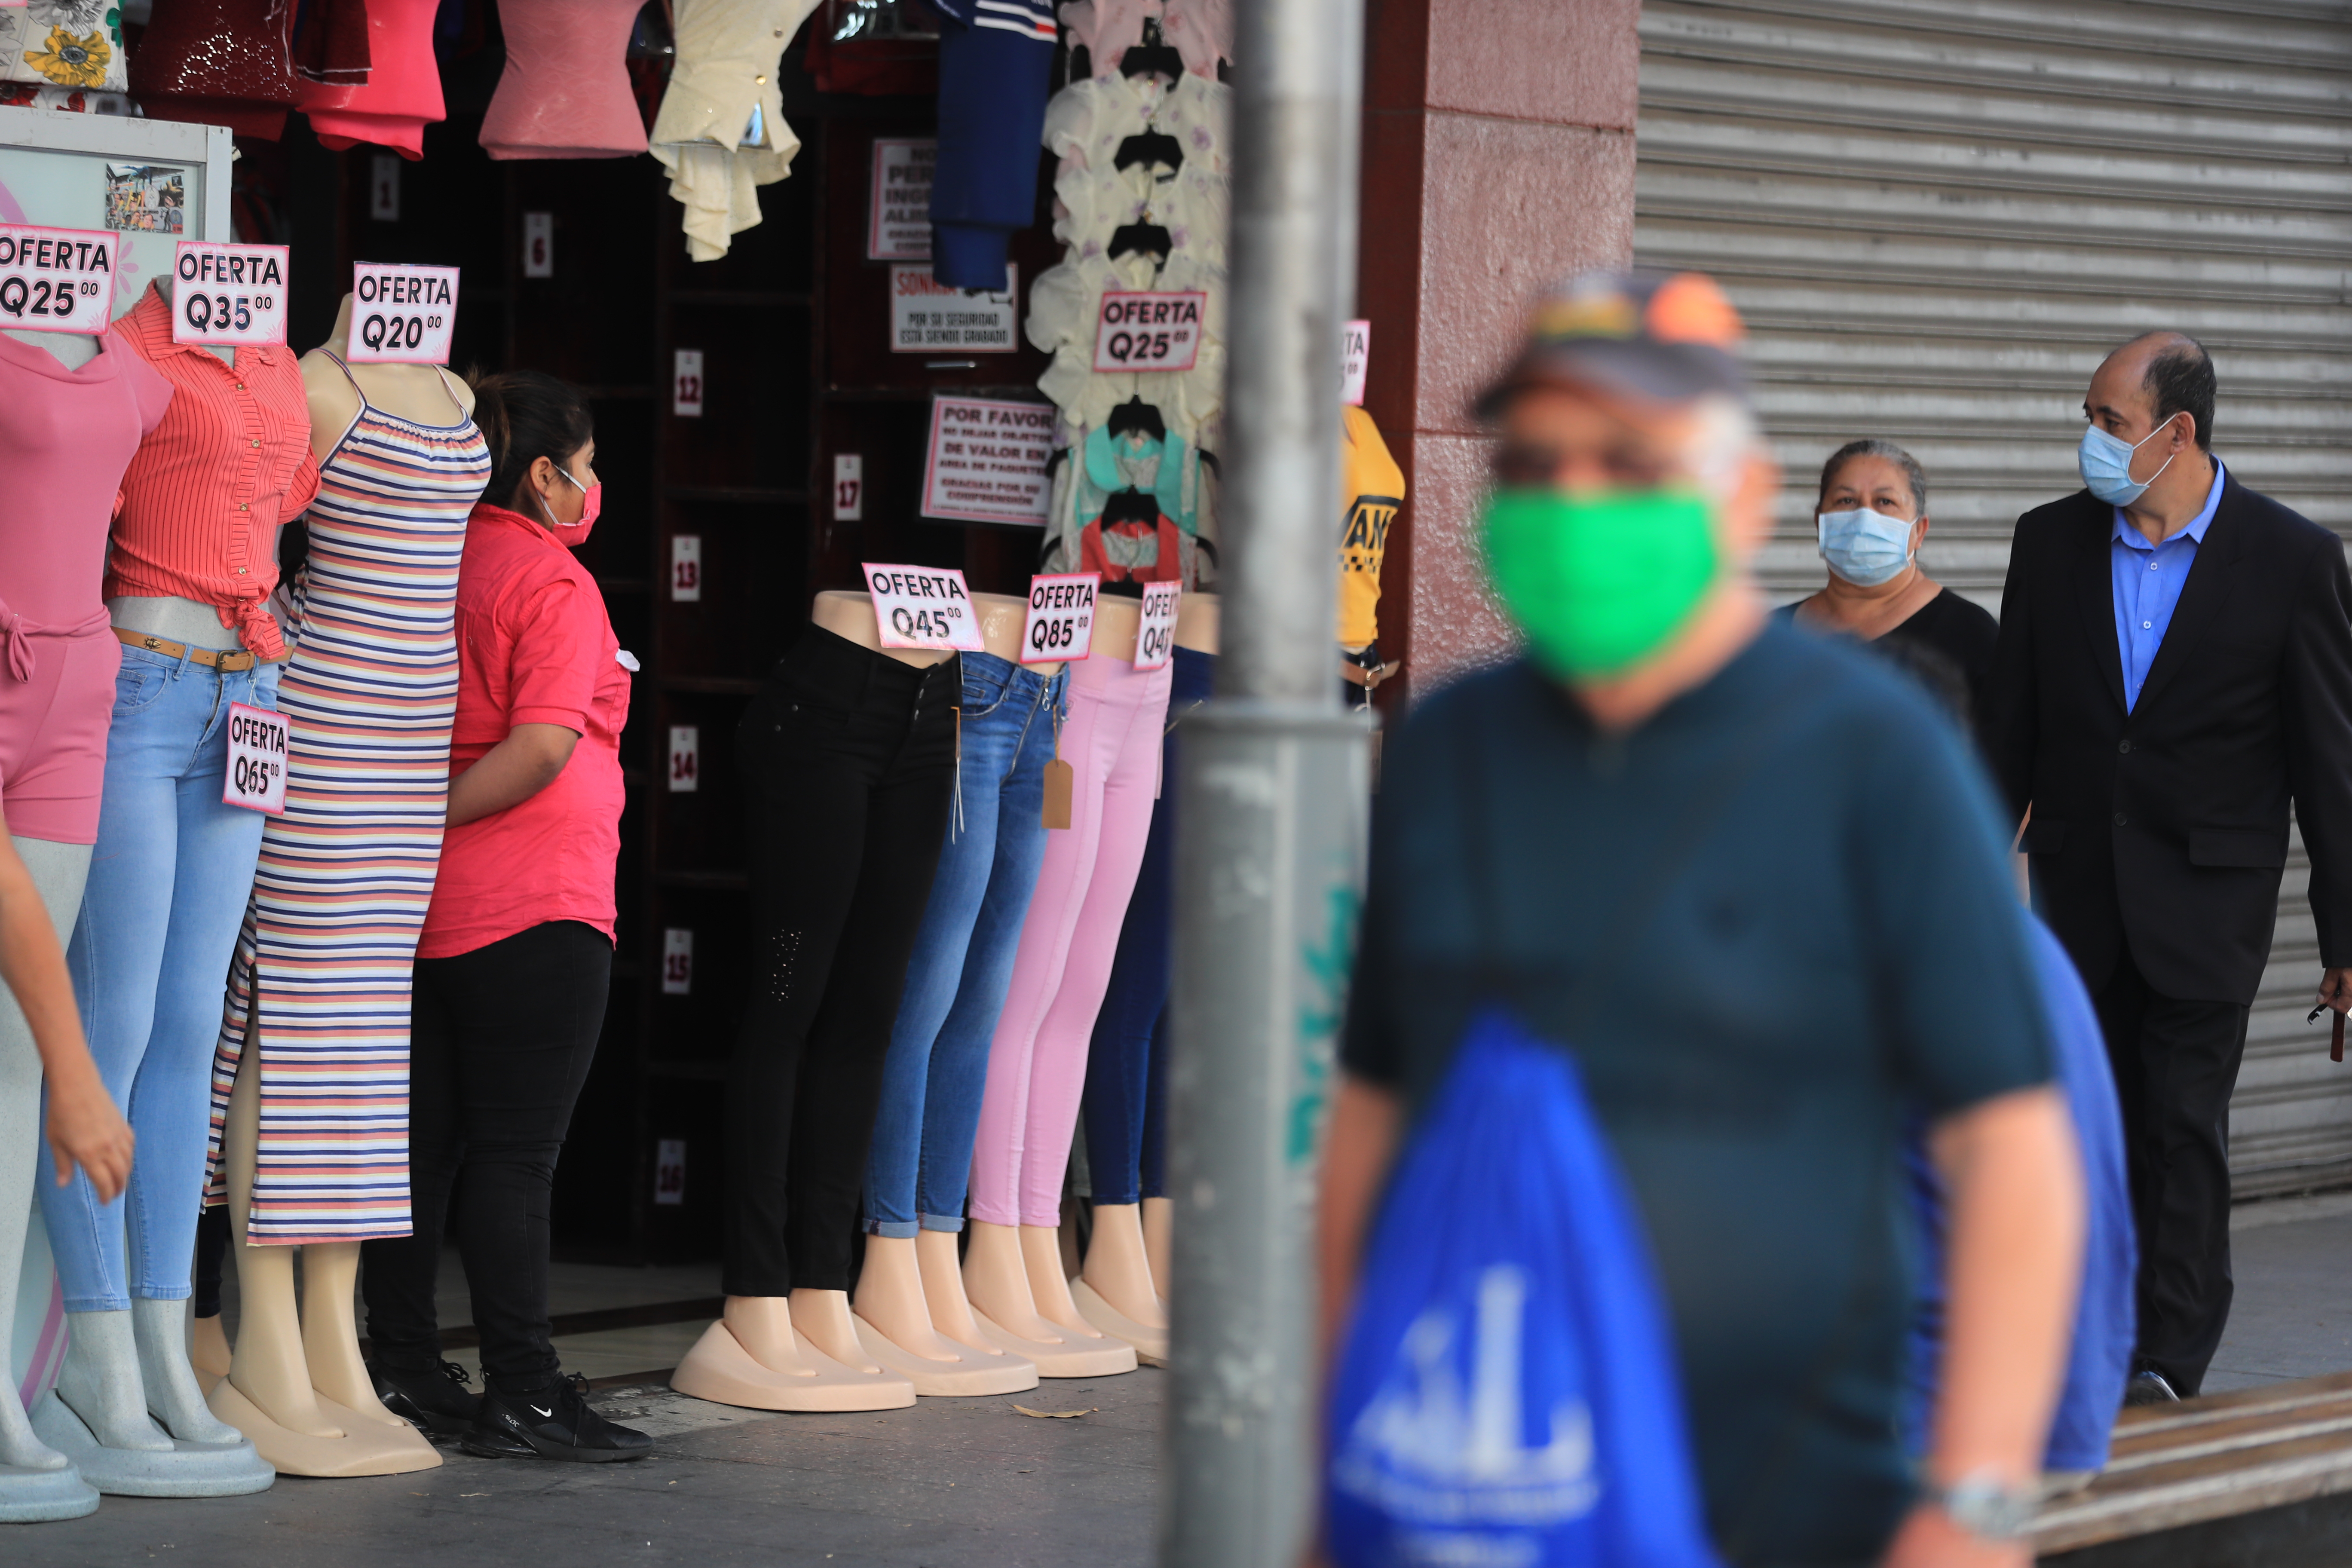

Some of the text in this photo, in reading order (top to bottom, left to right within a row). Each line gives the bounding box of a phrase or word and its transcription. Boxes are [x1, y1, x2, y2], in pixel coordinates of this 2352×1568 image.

[0, 236, 110, 273] OFERTA
[179, 253, 282, 286] OFERTA
[359, 275, 451, 305] OFERTA
[1105, 302, 1197, 323] OFERTA
[679, 375, 700, 404] 12
[944, 407, 1053, 429] POR FAVOR
[944, 442, 963, 454] DE
[969, 444, 1020, 459] VALOR
[839, 480, 858, 508] 17
[677, 561, 699, 590] 13
[872, 573, 966, 600] OFERTA
[1032, 584, 1093, 610] OFERTA
[232, 716, 285, 754] OFERTA
[674, 752, 694, 779] 14
[667, 954, 688, 982] 15
